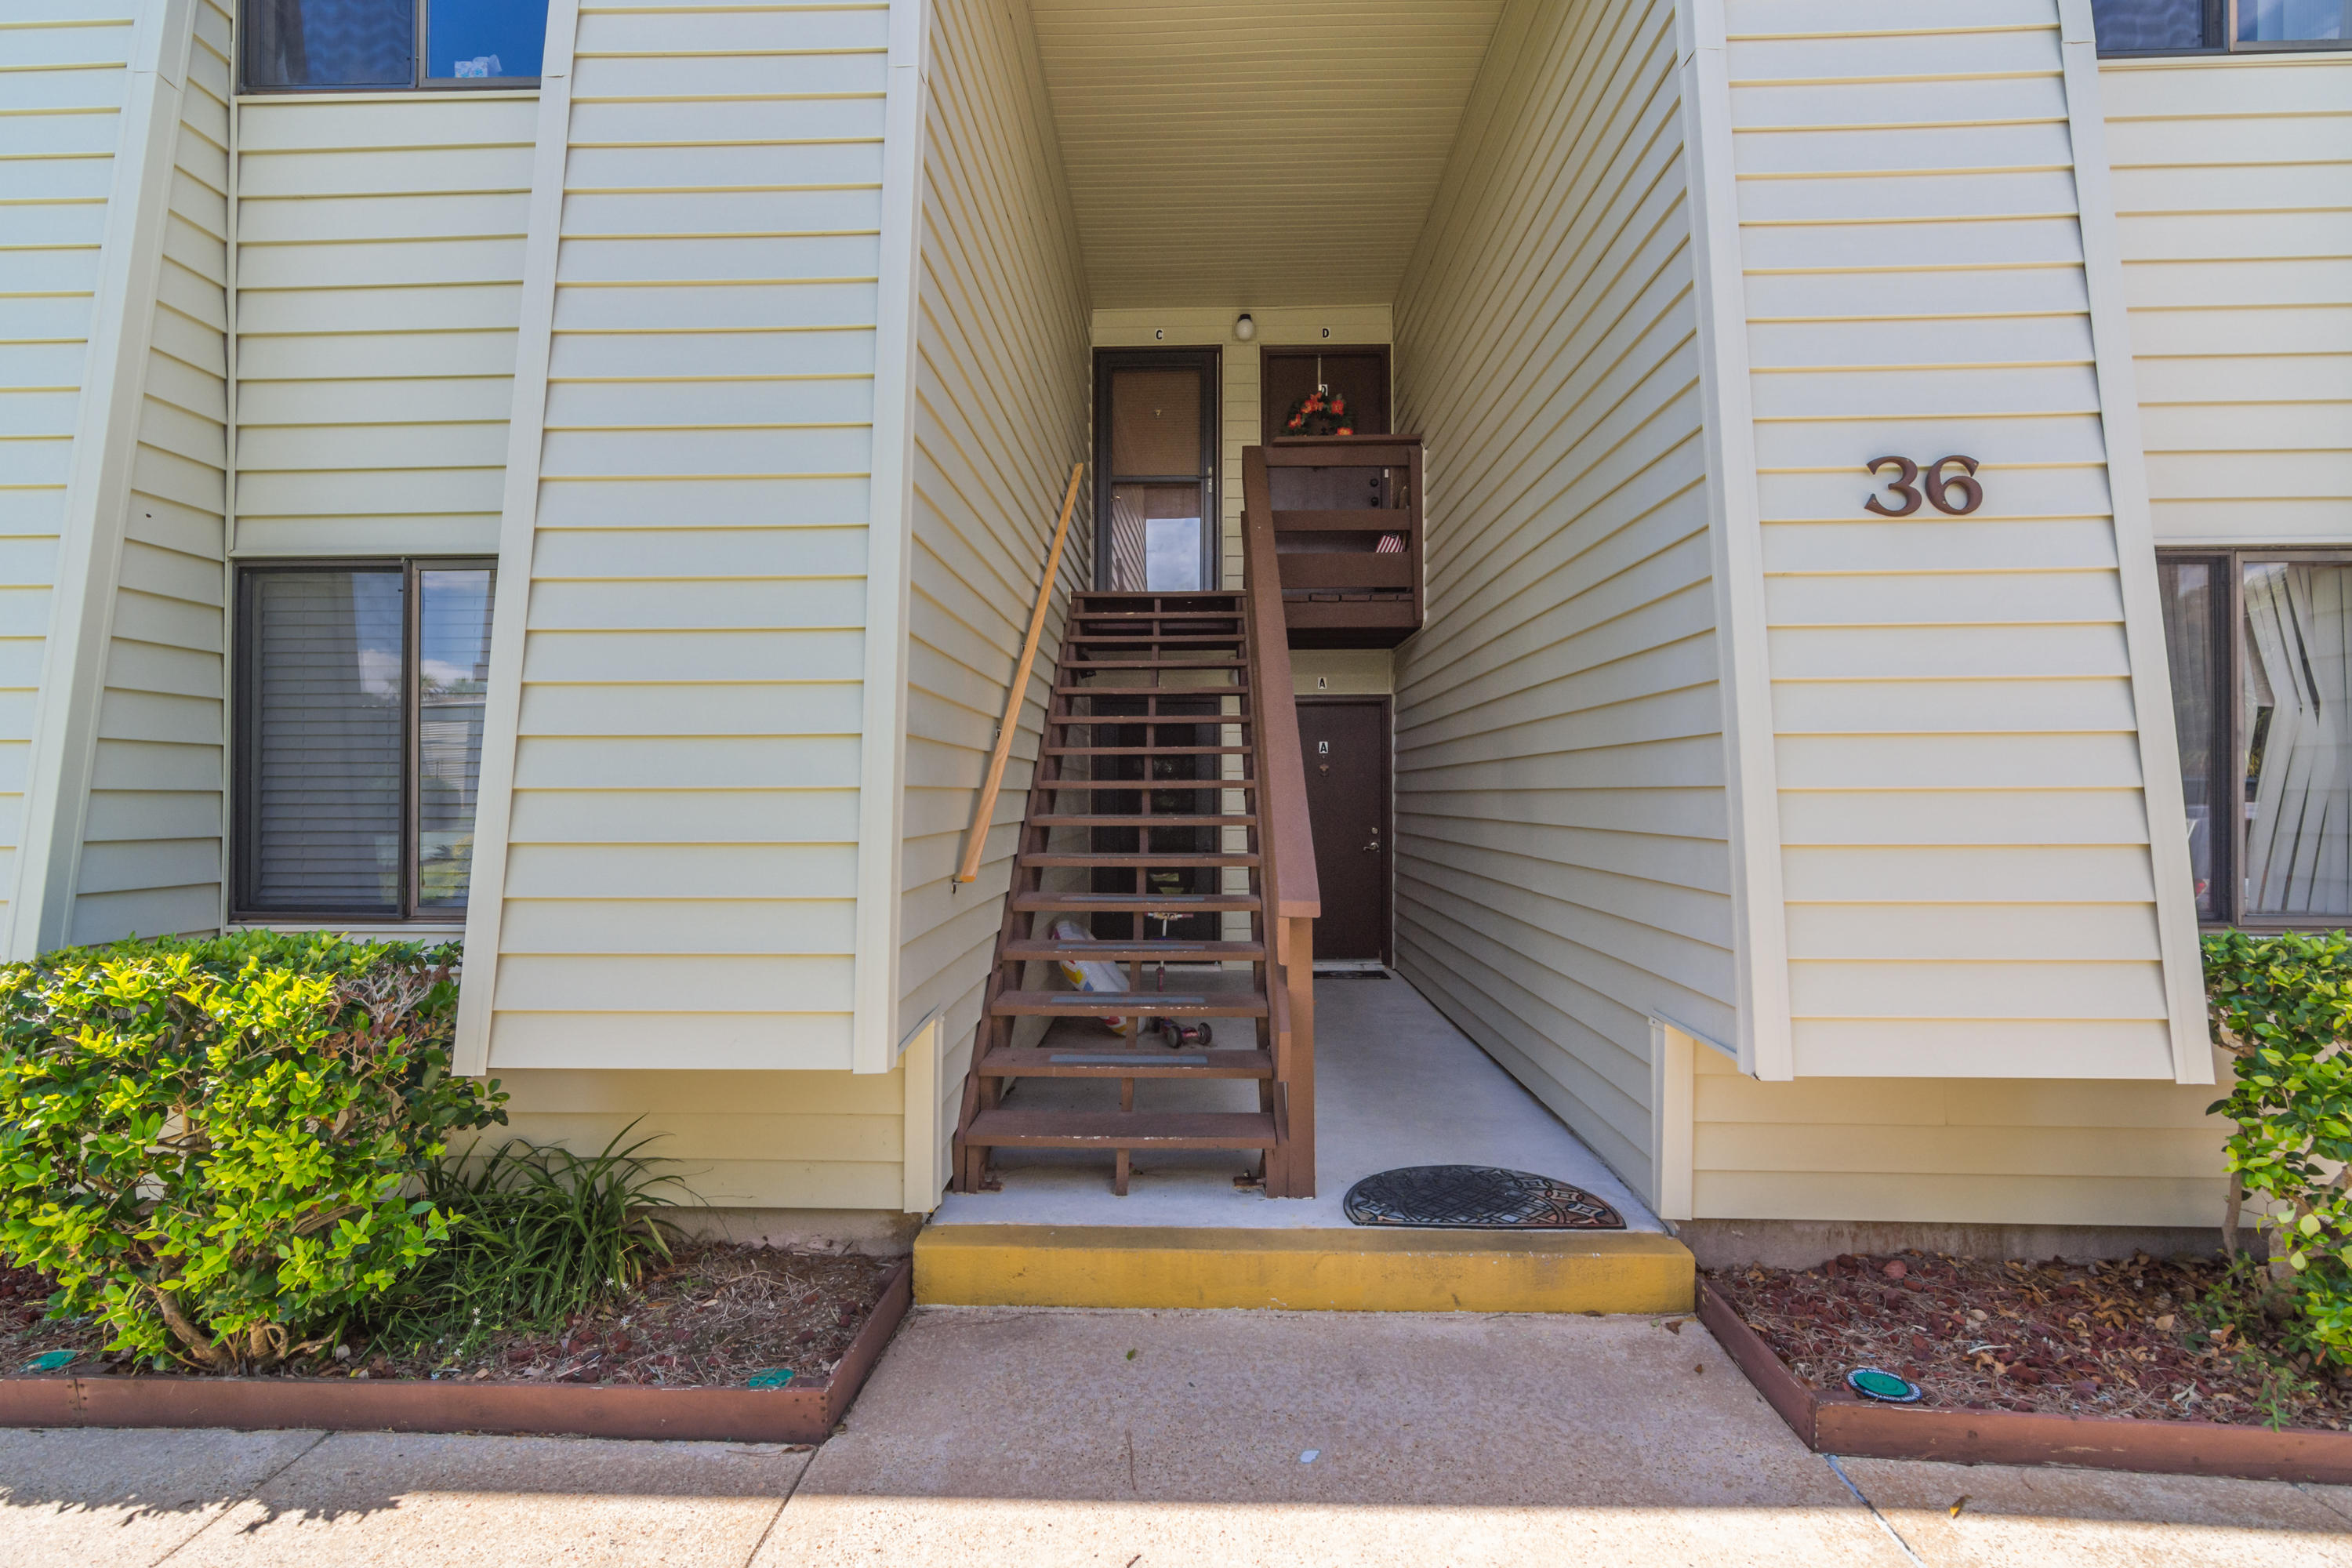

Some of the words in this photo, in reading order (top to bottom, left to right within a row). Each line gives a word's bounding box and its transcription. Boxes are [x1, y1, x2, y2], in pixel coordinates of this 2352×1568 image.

[1156, 329, 1163, 340] C
[1322, 328, 1330, 338] D
[1864, 455, 1984, 517] 36
[1319, 677, 1326, 688] A
[1320, 742, 1327, 753] A
